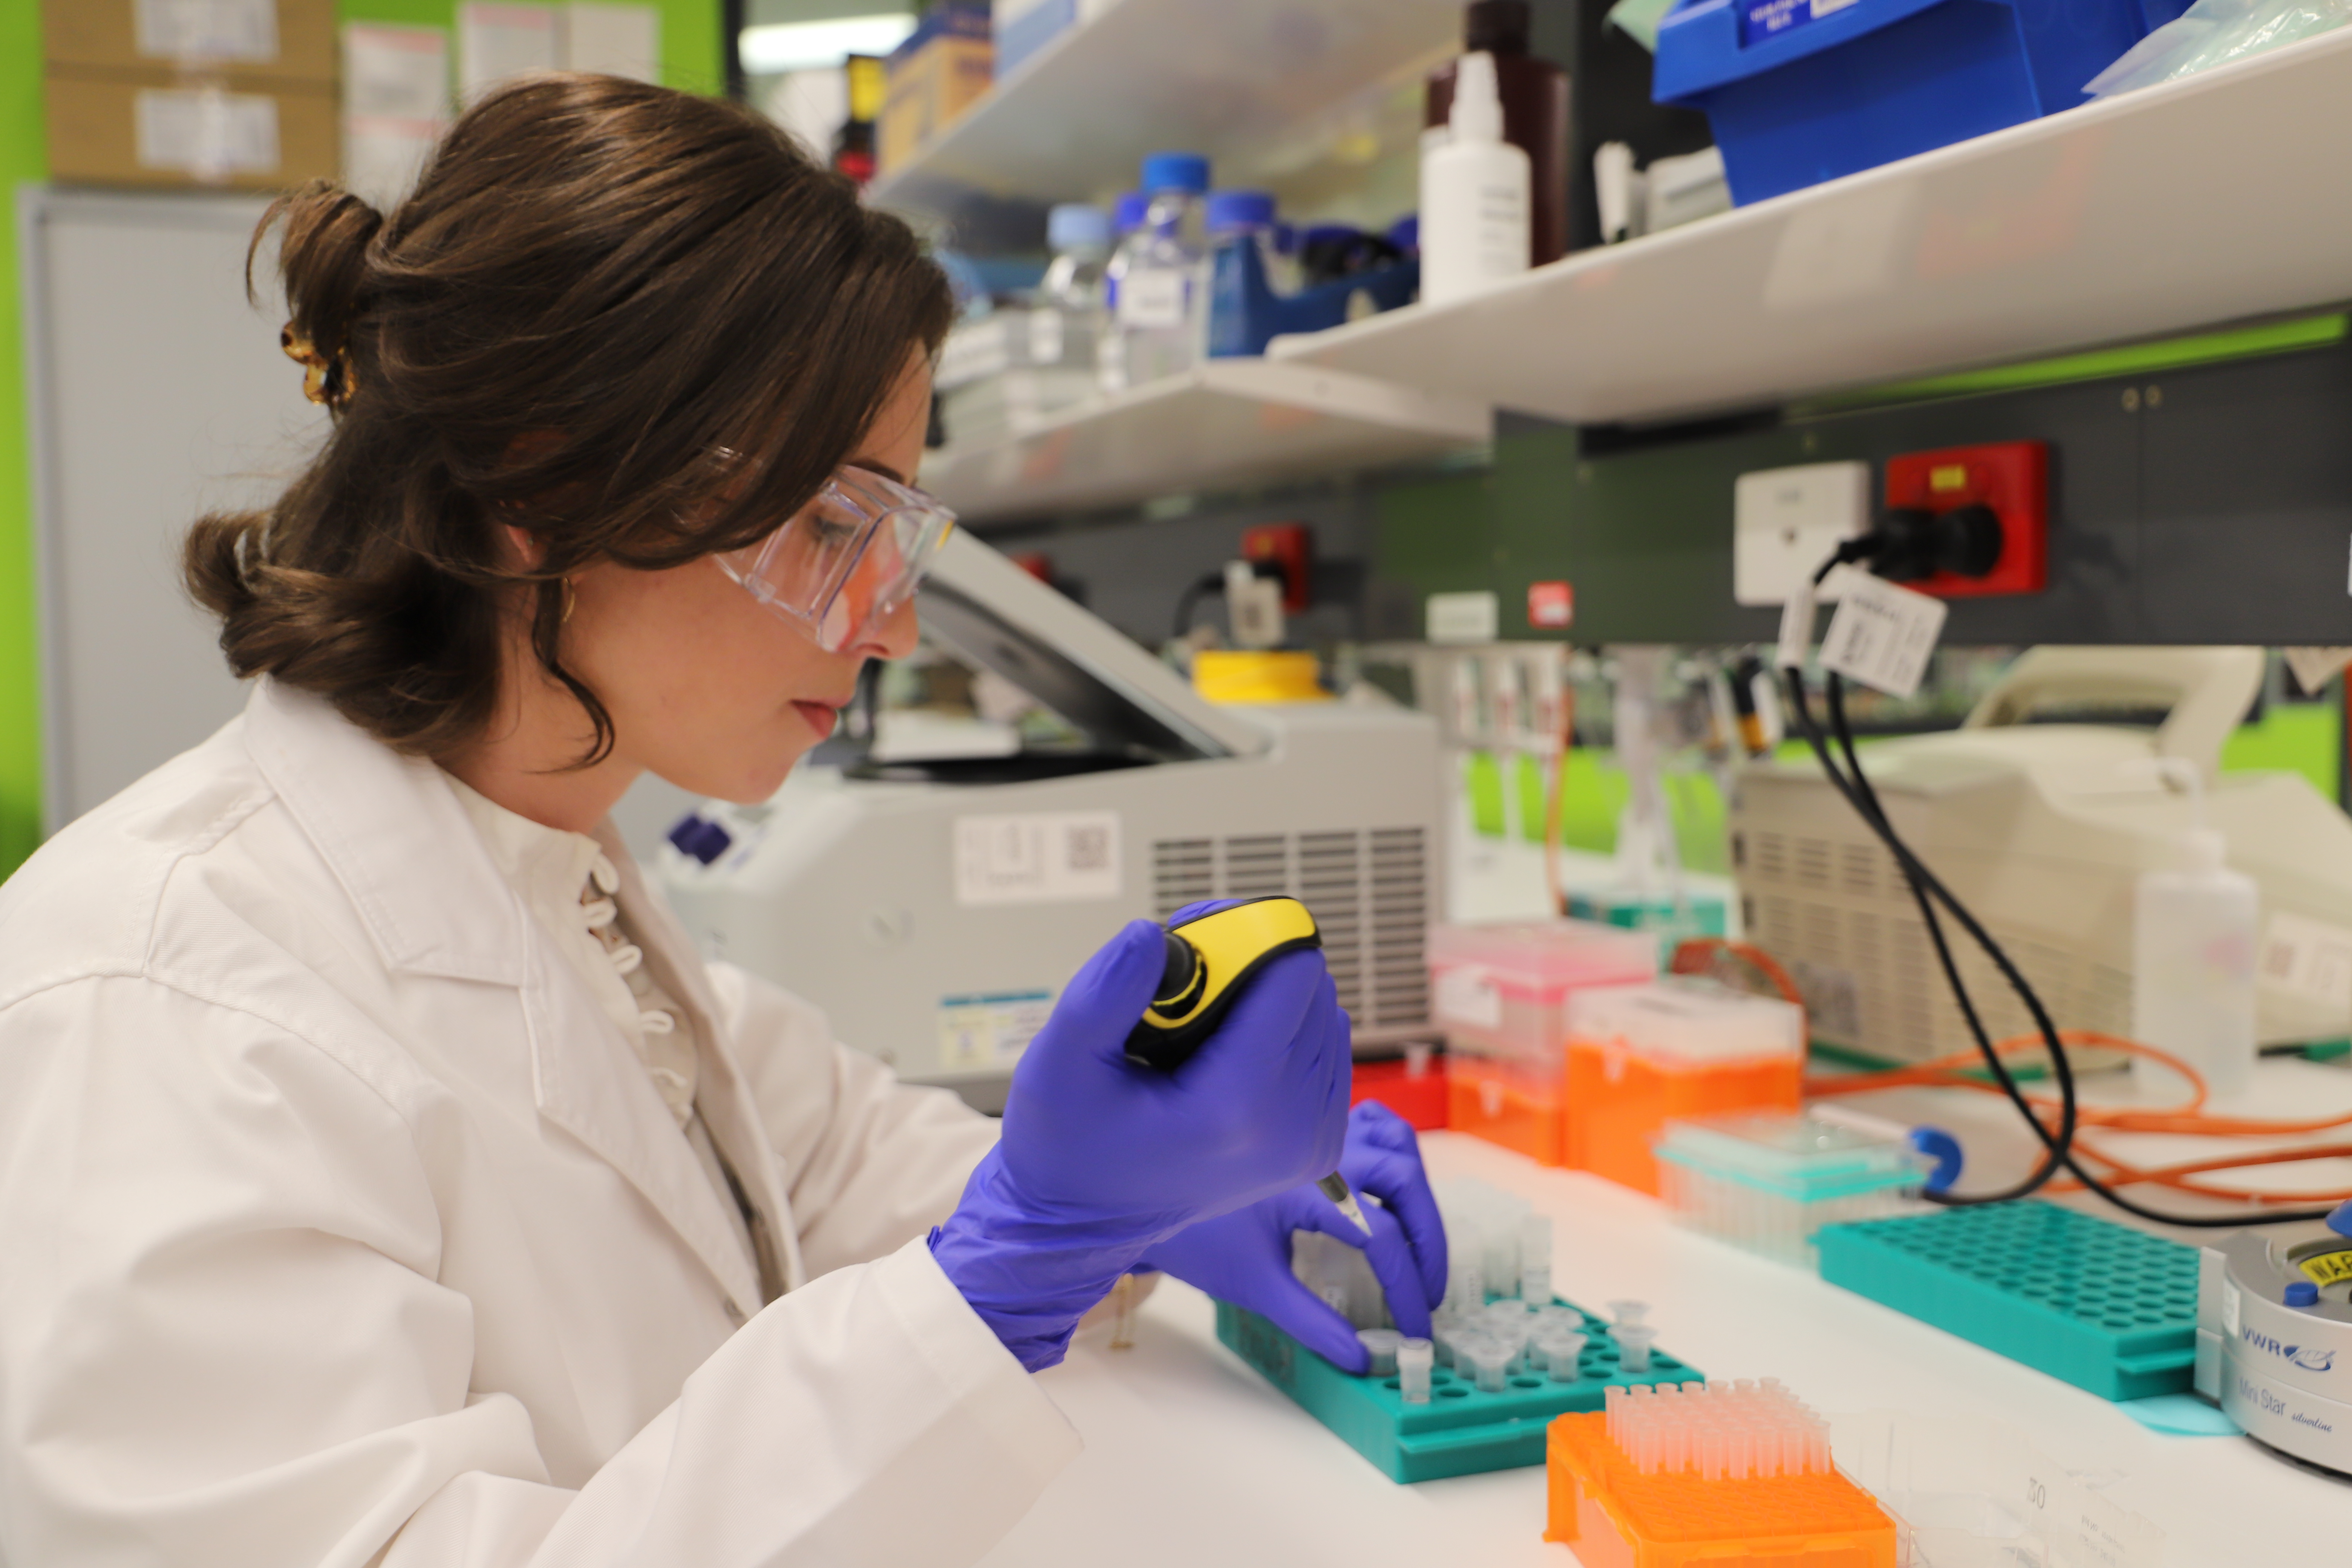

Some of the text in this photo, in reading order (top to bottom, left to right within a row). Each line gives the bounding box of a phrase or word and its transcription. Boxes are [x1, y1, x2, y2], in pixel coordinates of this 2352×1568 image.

[2243, 1324, 2280, 1356] VWR
[2239, 1376, 2332, 1433] Mini Star silverline
